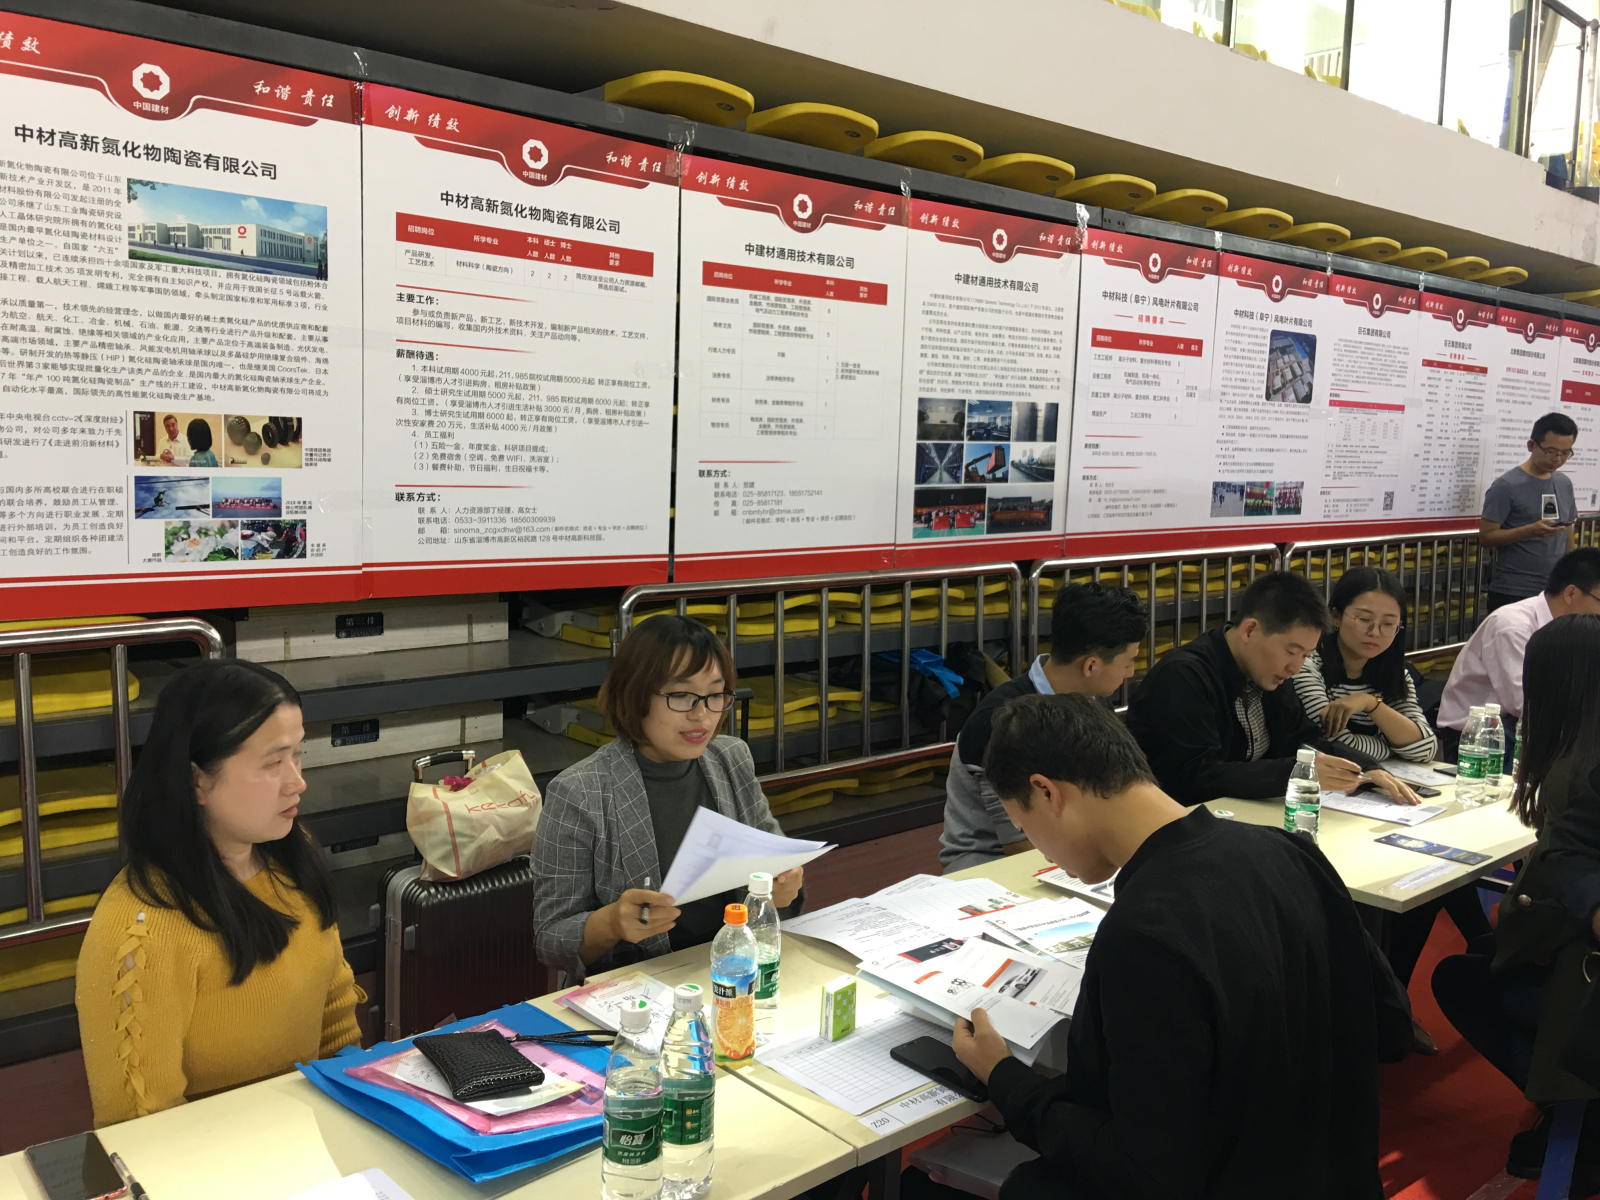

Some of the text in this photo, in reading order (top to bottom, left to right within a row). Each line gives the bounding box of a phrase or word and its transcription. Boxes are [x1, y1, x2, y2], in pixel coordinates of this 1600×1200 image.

[253, 80, 334, 108] 和谐 责任
[133, 100, 169, 114] 中国建材
[385, 104, 460, 132] 创新 绩效
[14, 124, 278, 180] 中材高新氮化物陶瓷有限公司
[606, 151, 662, 172] 和谐 责任
[522, 170, 548, 182] 中国建材
[696, 171, 749, 192] 创新 绩效
[440, 190, 620, 234] 中材高新氮化物陶瓷有限公司
[853, 200, 896, 216] 和谐 责任
[793, 220, 811, 229] 中国建材
[408, 224, 434, 236] 招聘岗位
[474, 234, 499, 245] 所学专业
[526, 236, 539, 244] 本科
[544, 239, 556, 247] 硕士
[560, 242, 572, 250] 博士
[408, 258, 435, 267] 工艺技术
[544, 252, 556, 260] 人数
[560, 254, 572, 262] 人数
[745, 243, 855, 269] 中建材通用技术有限公司
[955, 272, 1038, 293] 中建材通用技术有限公司
[396, 292, 439, 305] 主要工作：
[1102, 290, 1199, 311] 中材科技（阜宁）风电叶片有限公司
[396, 348, 439, 361] 薪酬待遇：
[424, 430, 455, 440] 员工福利
[698, 470, 731, 478] 联系方式：
[395, 492, 441, 502] 联系方式：
[713, 984, 734, 996] 美汁源
[871, 1117, 890, 1129] Z20
